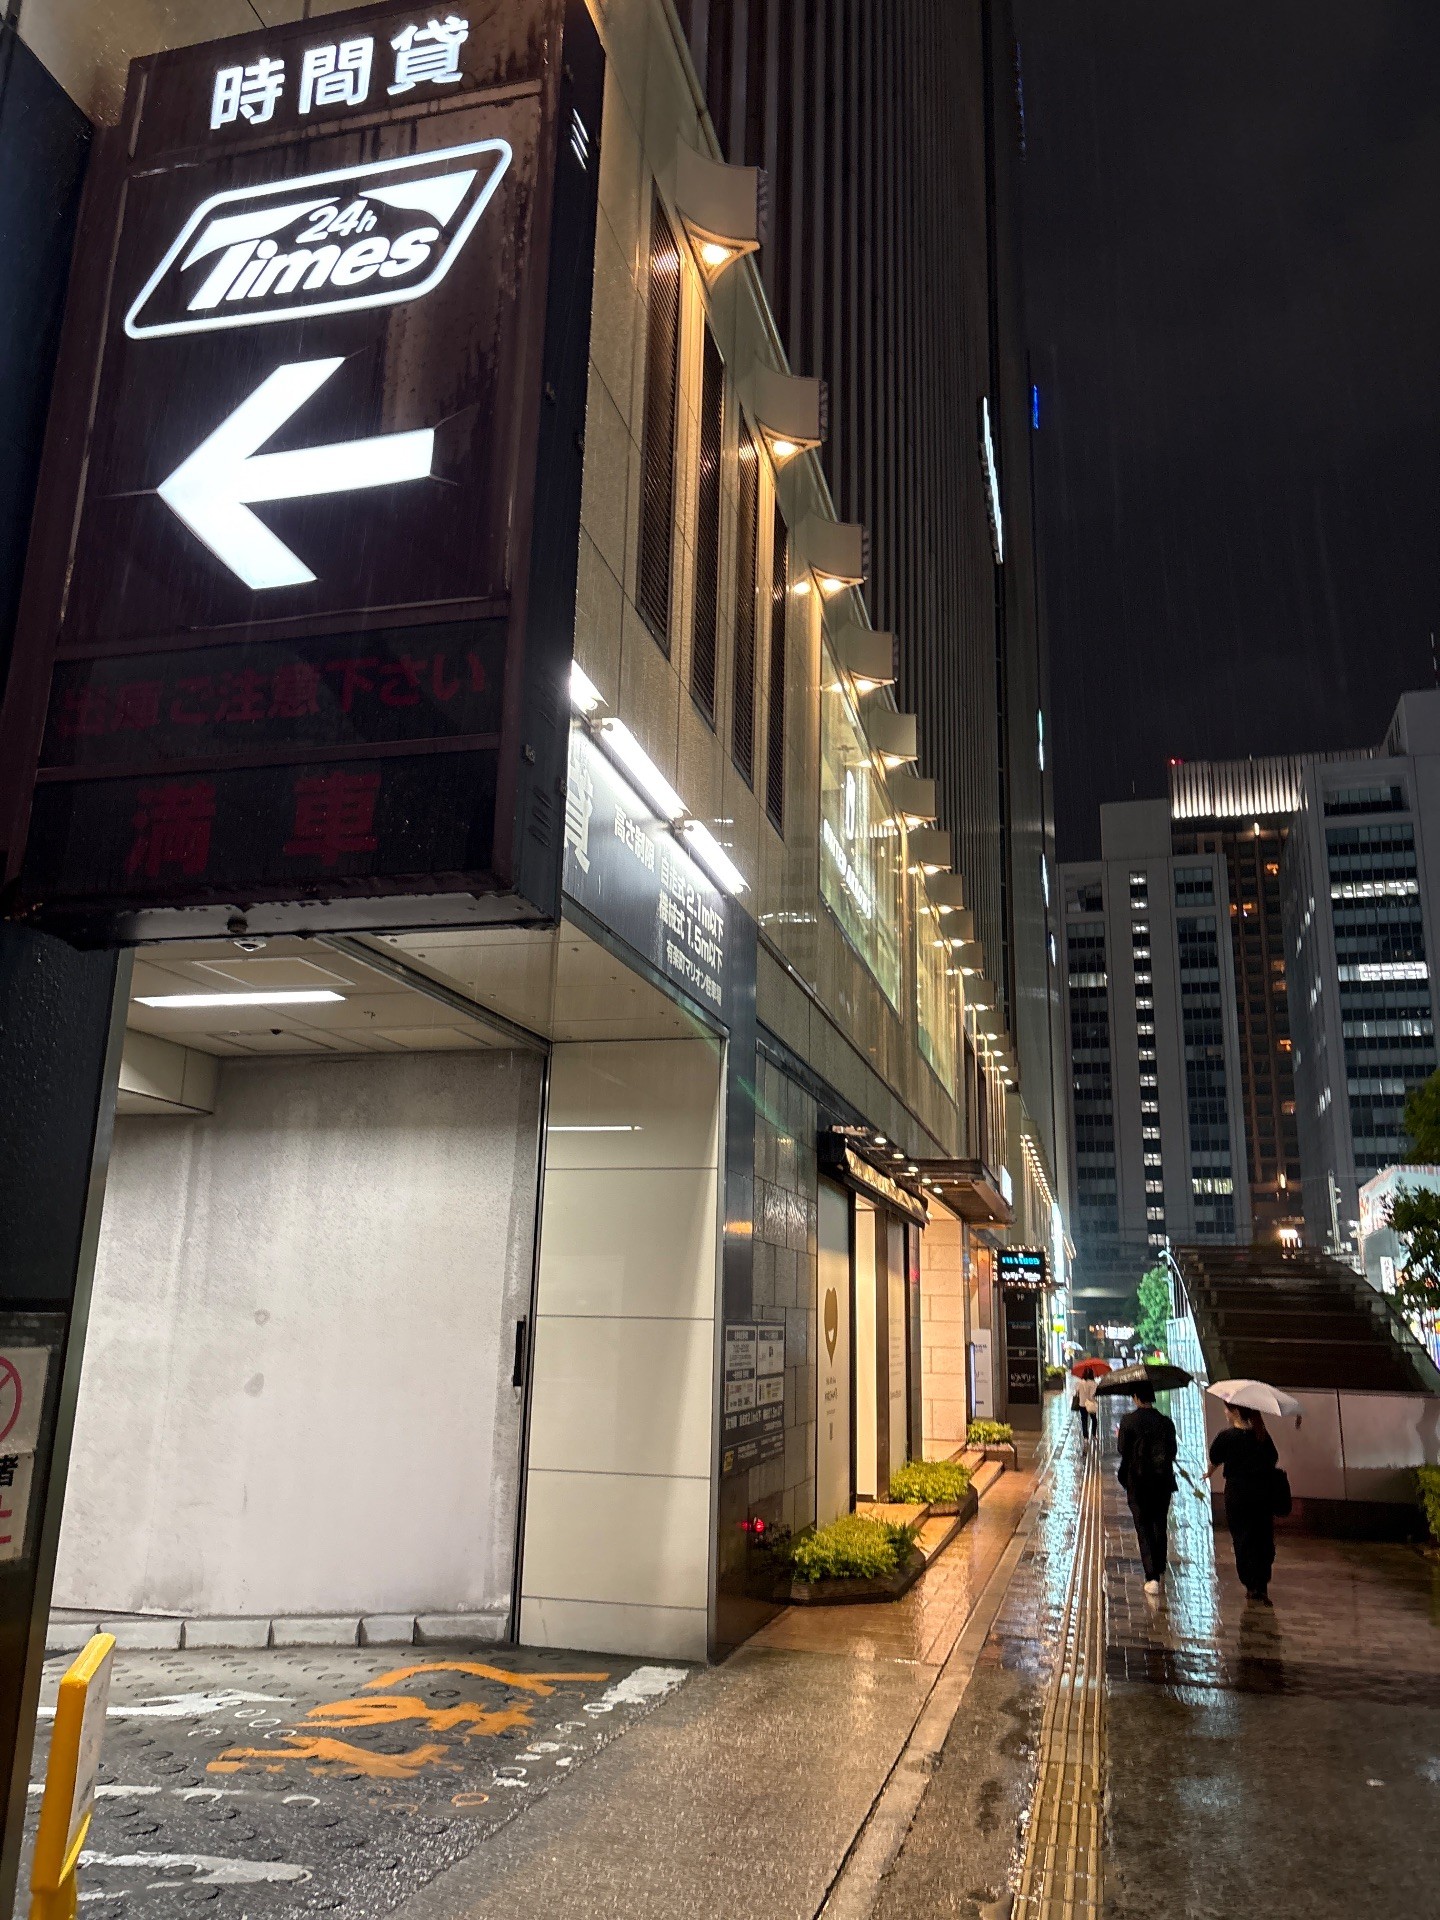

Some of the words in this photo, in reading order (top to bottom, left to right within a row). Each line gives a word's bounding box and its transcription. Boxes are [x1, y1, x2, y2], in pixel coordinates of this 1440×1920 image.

[209, 15, 469, 130] 時間貸
[295, 198, 377, 245] 24h
[187, 226, 439, 311] Times
[614, 803, 655, 873] 高さ制限
